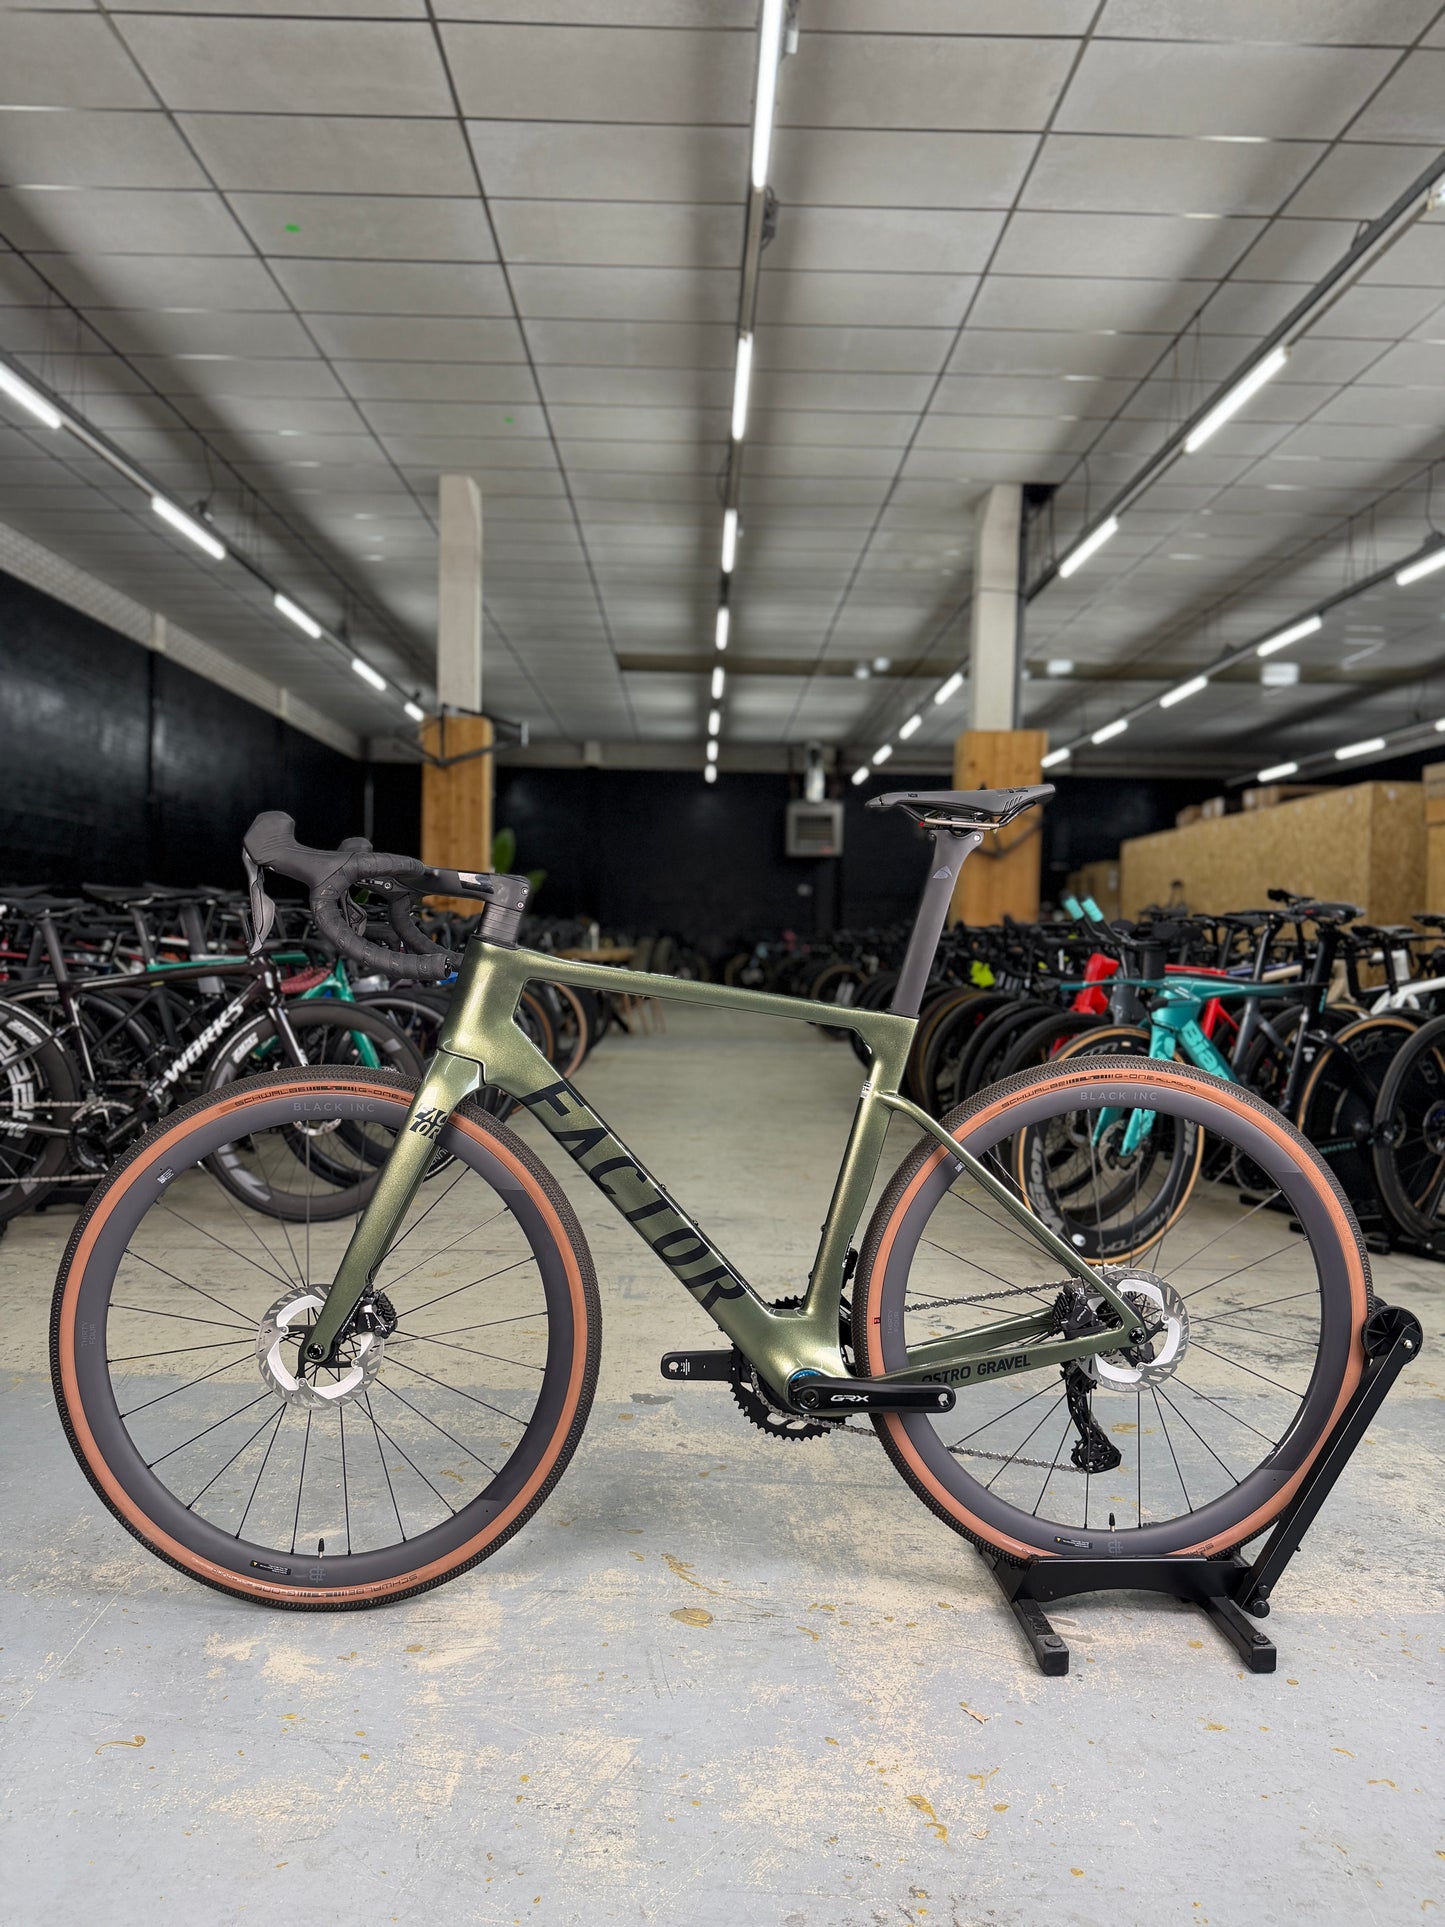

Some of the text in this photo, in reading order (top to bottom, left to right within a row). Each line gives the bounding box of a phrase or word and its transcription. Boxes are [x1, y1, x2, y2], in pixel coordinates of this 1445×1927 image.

[234, 1086, 306, 1107] SCHWALBE
[358, 1086, 399, 1100] G-ONE
[1001, 1080, 1067, 1109] SCHWALBE
[1114, 1073, 1154, 1081] G-ONE
[1080, 1091, 1158, 1101] BLACK INC
[293, 1102, 376, 1113] BLACK INC
[517, 1078, 747, 1312] FACTOR
[921, 1354, 1032, 1384] OSTRO GRAVEL
[830, 1394, 870, 1403] GRX
